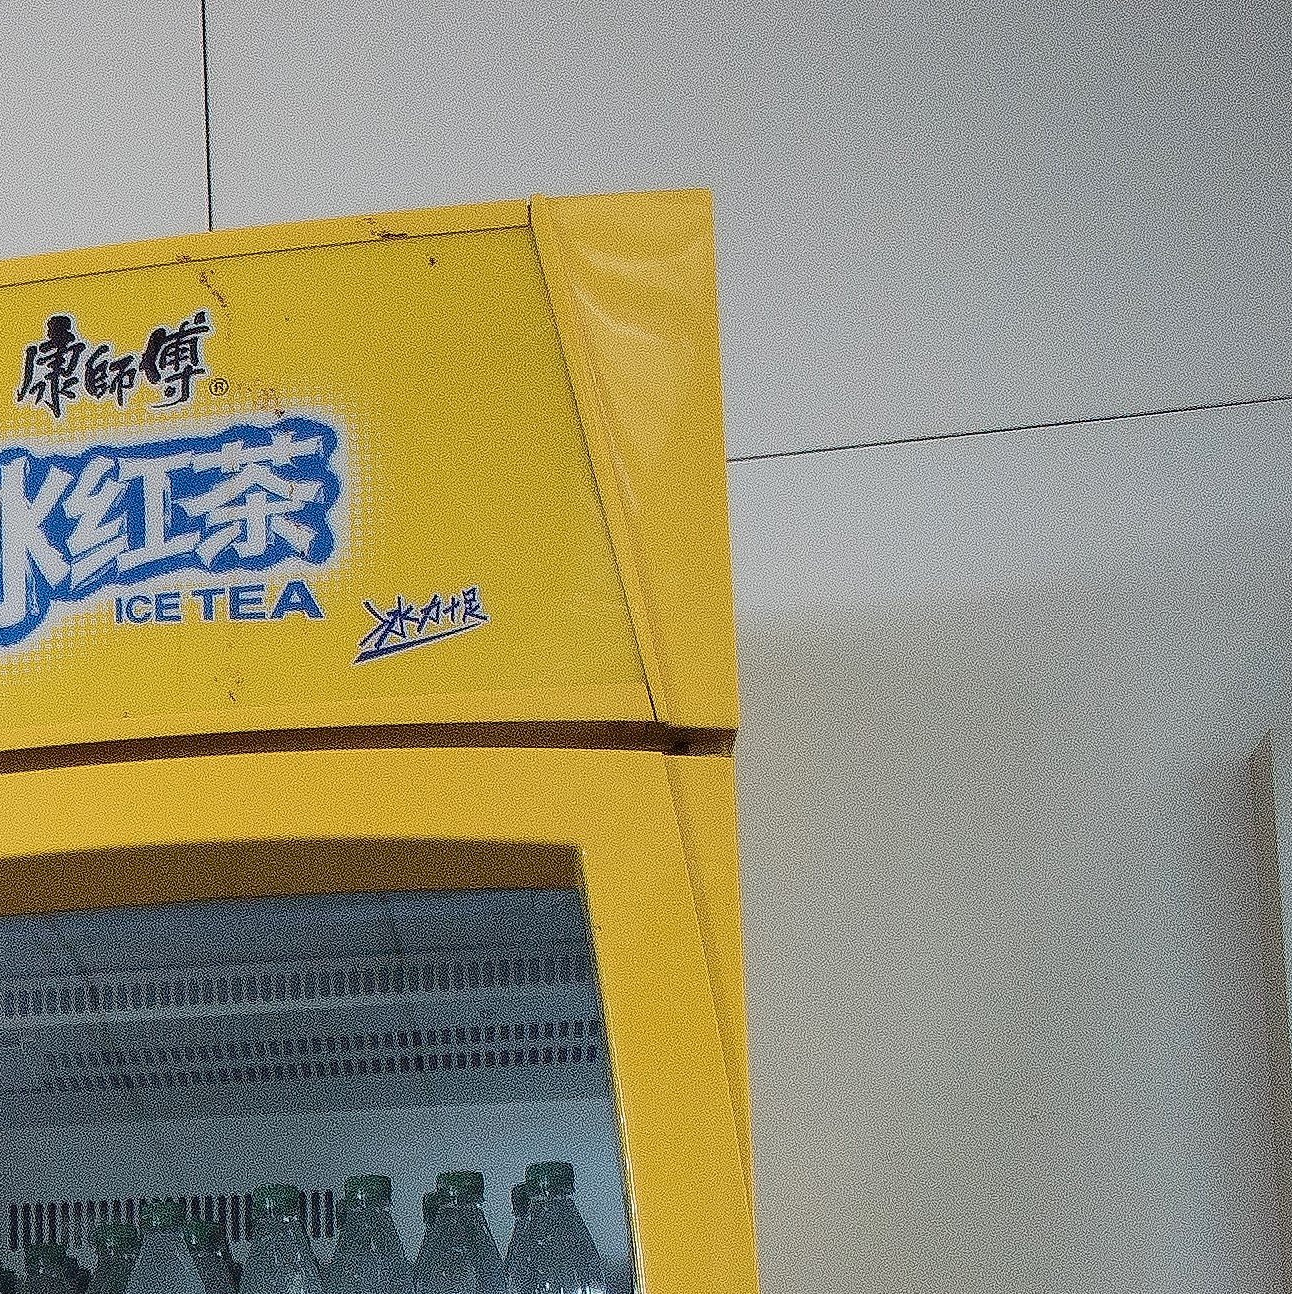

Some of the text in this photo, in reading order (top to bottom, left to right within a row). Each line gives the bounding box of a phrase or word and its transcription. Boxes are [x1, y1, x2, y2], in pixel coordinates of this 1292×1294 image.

[17, 312, 209, 418] 康師傅
[115, 580, 323, 626] ICE TEA
